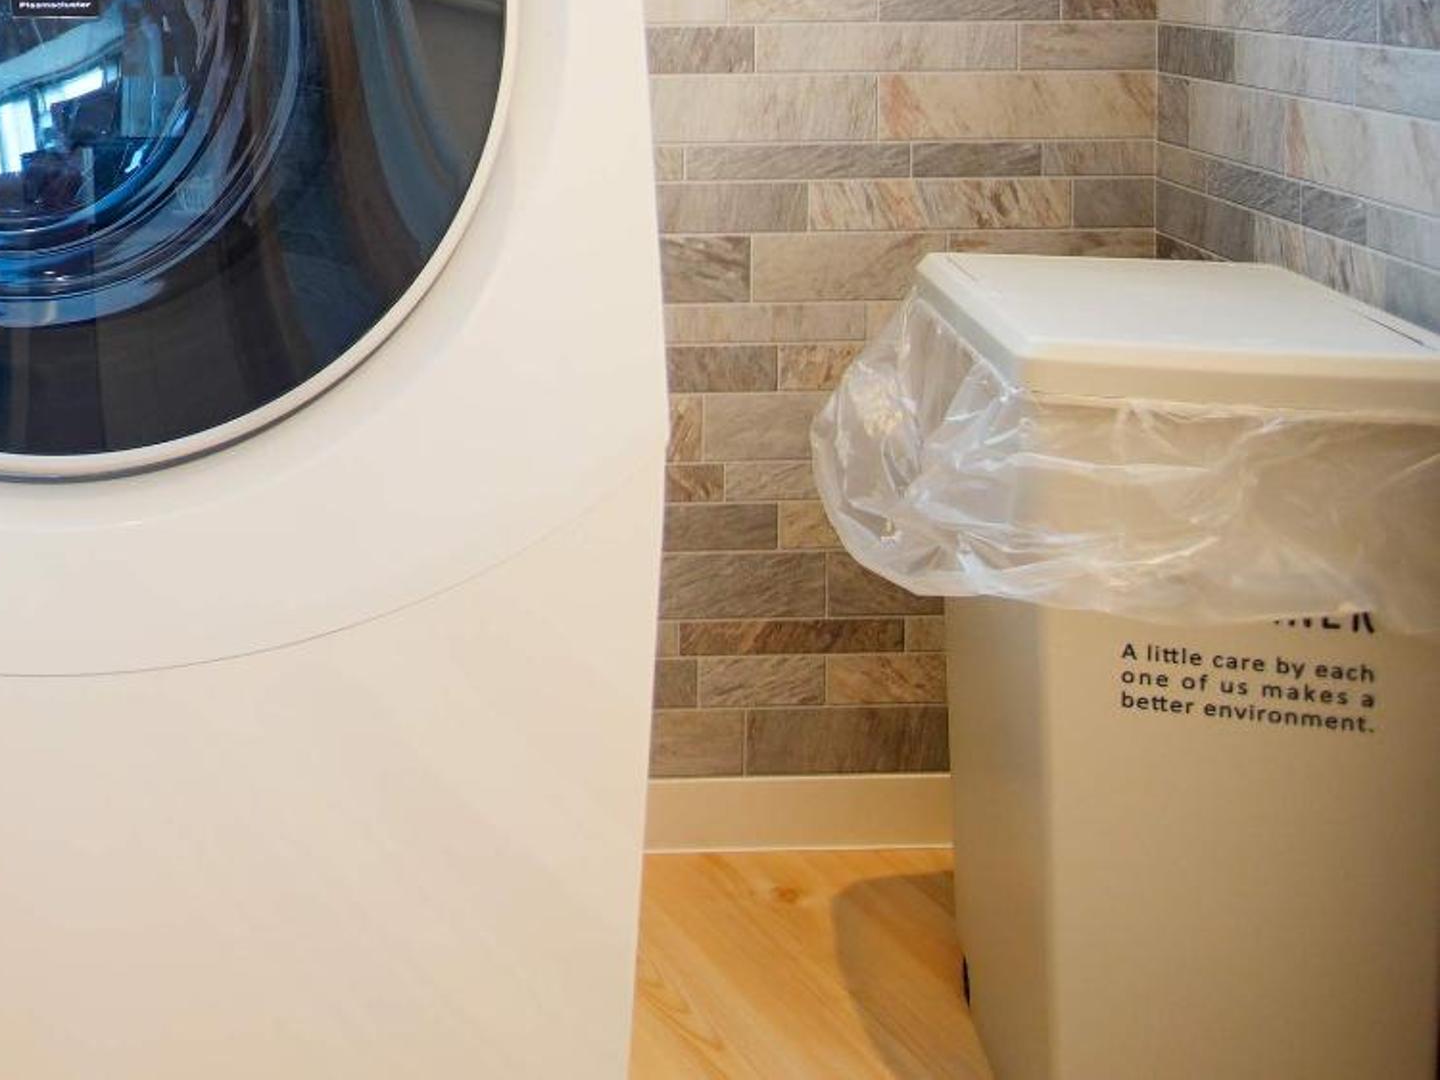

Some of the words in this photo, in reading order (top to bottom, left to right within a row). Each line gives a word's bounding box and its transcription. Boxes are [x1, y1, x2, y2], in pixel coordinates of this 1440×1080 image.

[18, 1, 92, 9] Plasmacluster
[1121, 643, 1138, 661] A
[1146, 645, 1202, 666] little
[1212, 654, 1266, 672] care
[1275, 656, 1306, 680] by
[1315, 664, 1375, 683] each
[1121, 670, 1169, 688] one
[1181, 674, 1209, 691] of
[1220, 681, 1249, 696] us
[1261, 682, 1350, 706] makes
[1361, 693, 1375, 708] a
[1121, 691, 1195, 714] better
[1203, 702, 1376, 734] environment.
